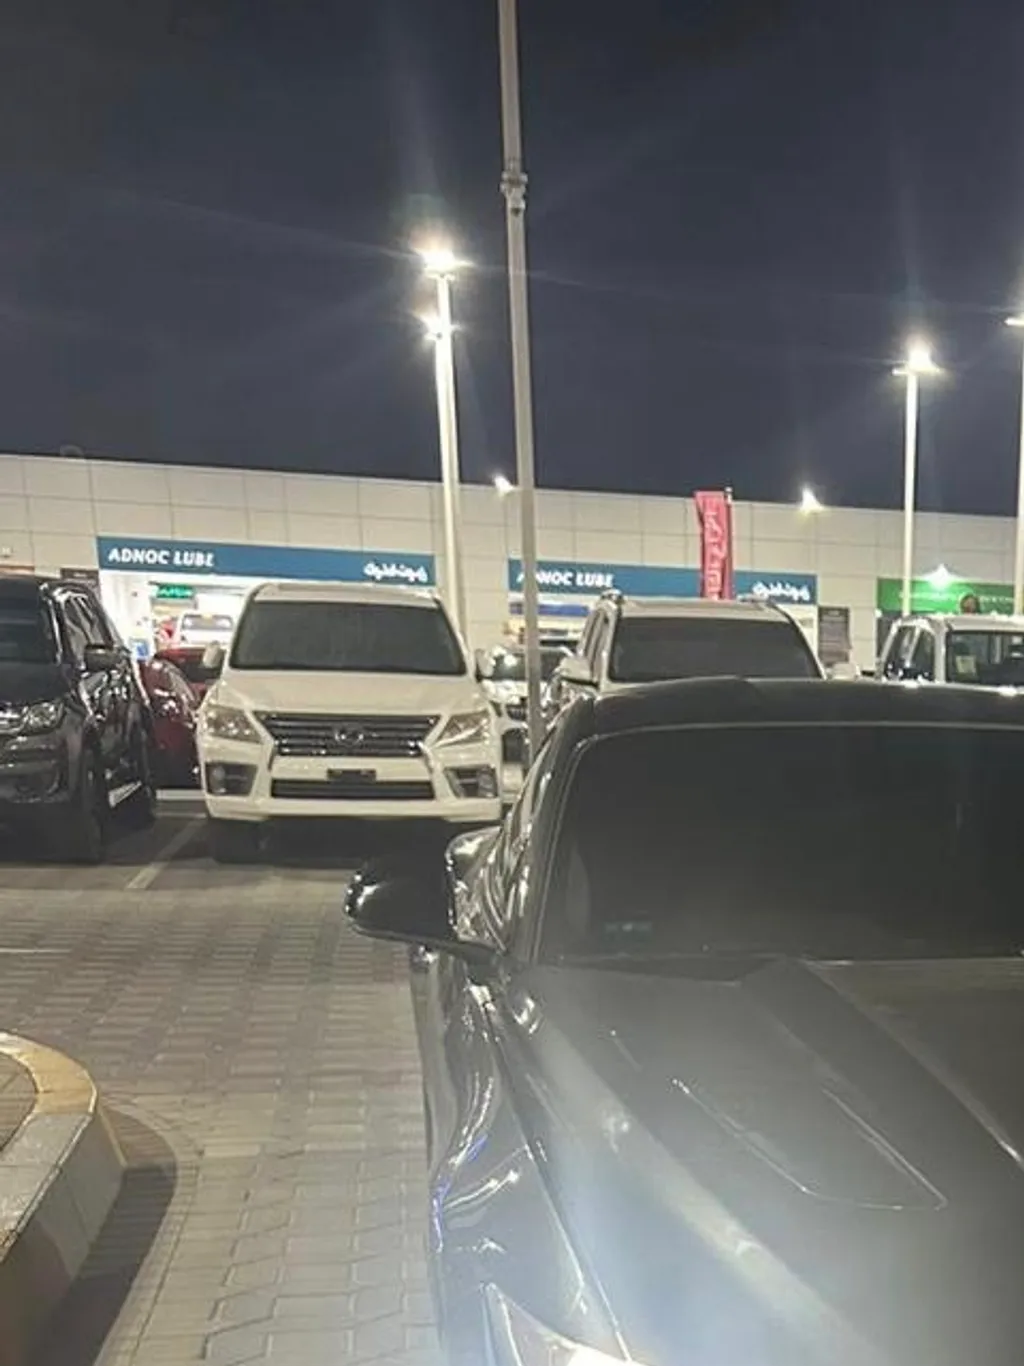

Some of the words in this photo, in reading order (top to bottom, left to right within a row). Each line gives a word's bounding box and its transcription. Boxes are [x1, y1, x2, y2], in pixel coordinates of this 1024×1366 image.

[108, 547, 170, 565] ADNOC
[173, 550, 215, 567] LUBE
[516, 569, 573, 586] NOC
[576, 572, 615, 588] LUBE
